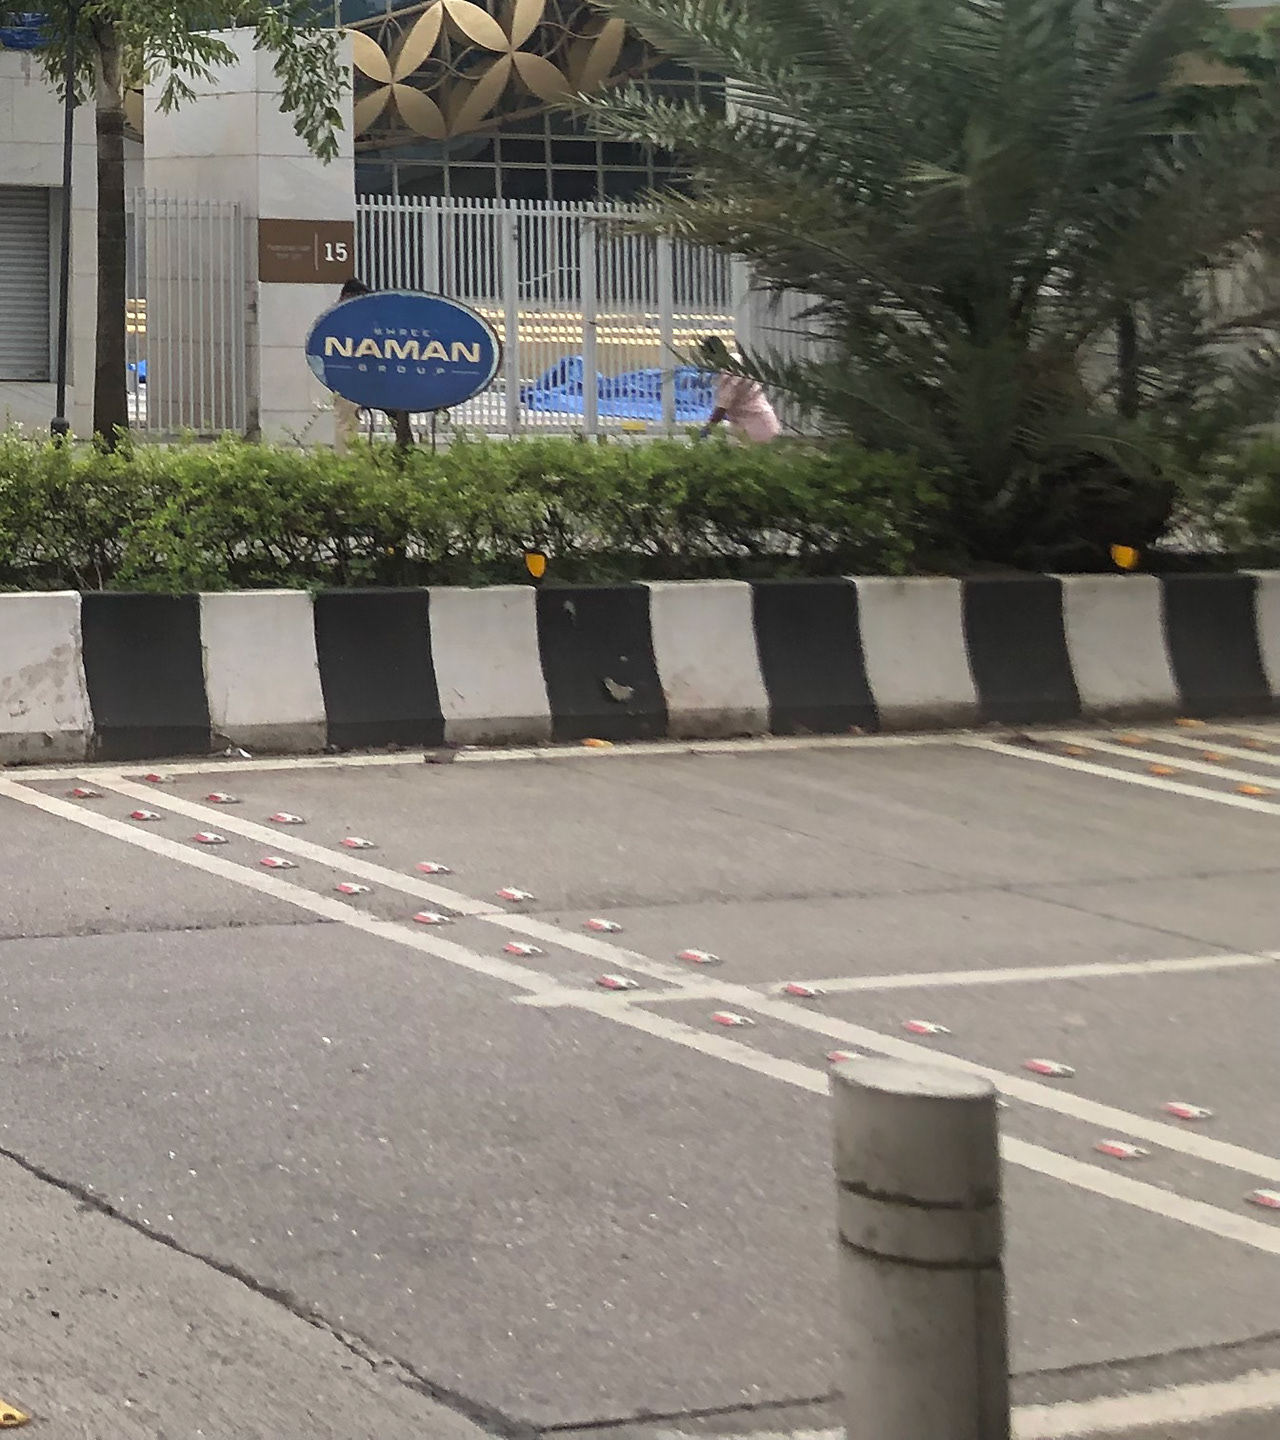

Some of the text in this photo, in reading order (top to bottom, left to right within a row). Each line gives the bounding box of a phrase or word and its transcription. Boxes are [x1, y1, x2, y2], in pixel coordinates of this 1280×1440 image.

[324, 242, 349, 263] 15
[324, 336, 481, 363] NAMAN
[357, 363, 446, 375] GROUP
